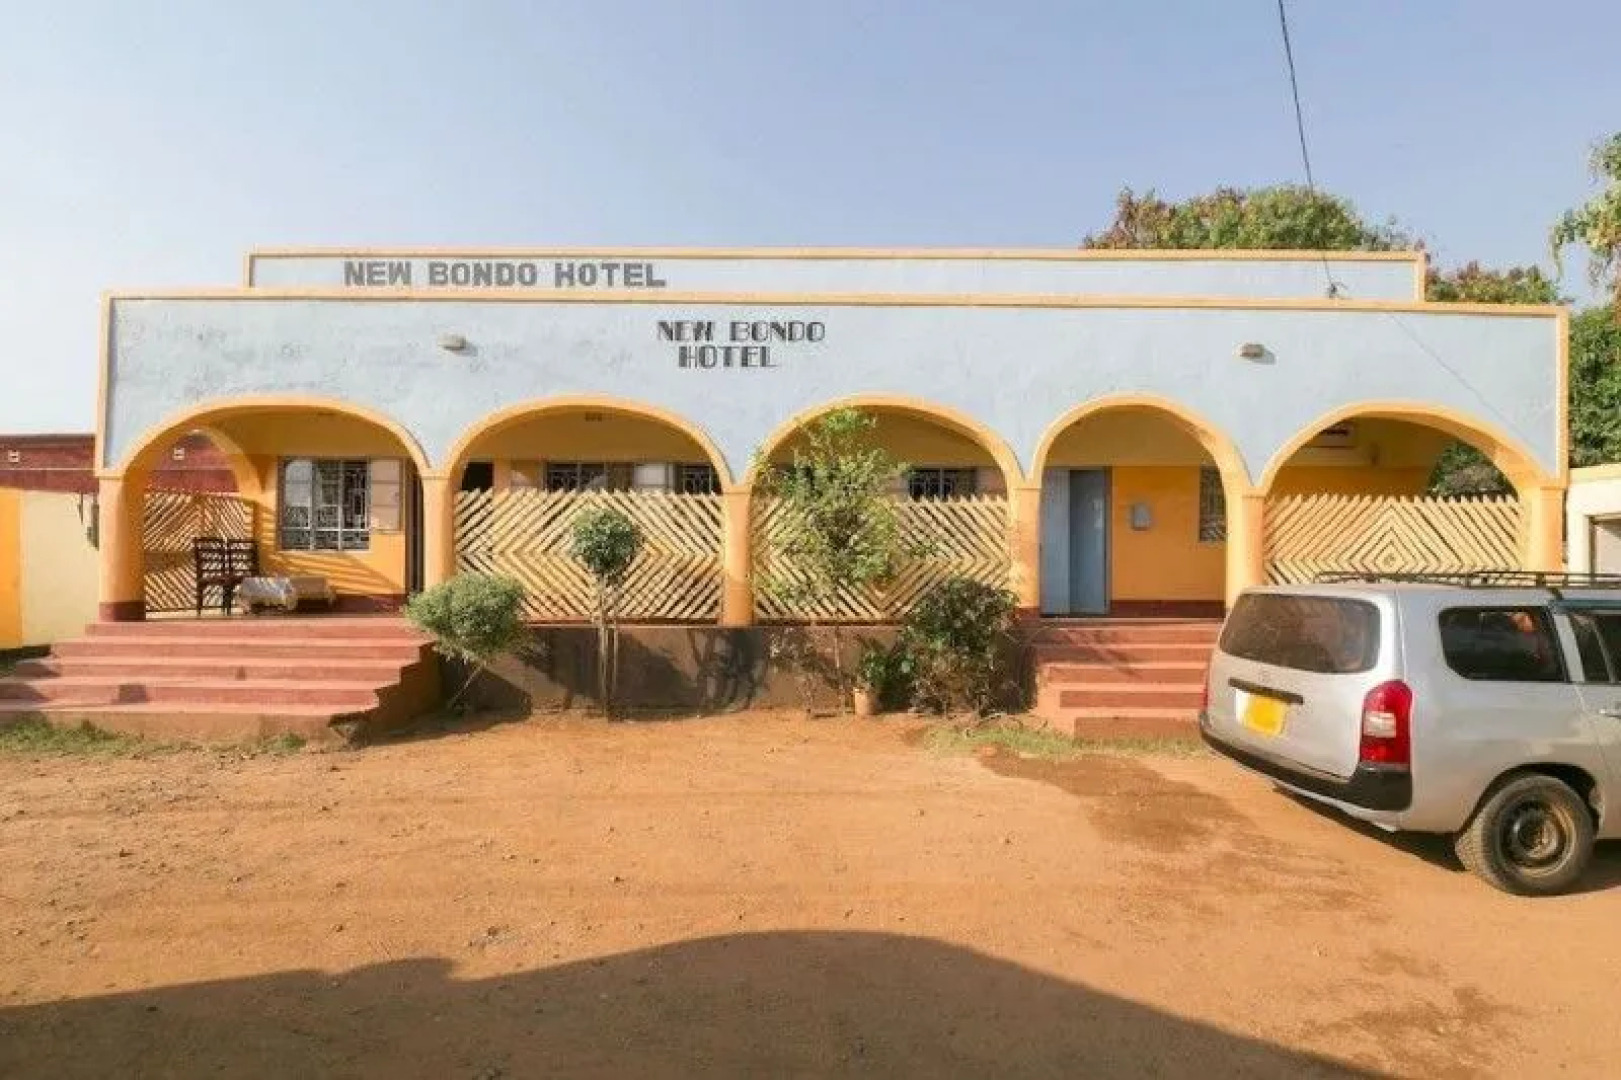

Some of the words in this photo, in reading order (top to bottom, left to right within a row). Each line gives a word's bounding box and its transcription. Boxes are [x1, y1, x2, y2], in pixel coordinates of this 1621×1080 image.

[343, 261, 412, 287] NEW
[428, 261, 538, 287] BONDO
[554, 262, 666, 288] HOTEL
[657, 320, 715, 342] NEW
[729, 321, 826, 342] BONDO
[678, 345, 778, 368] HOTEL
